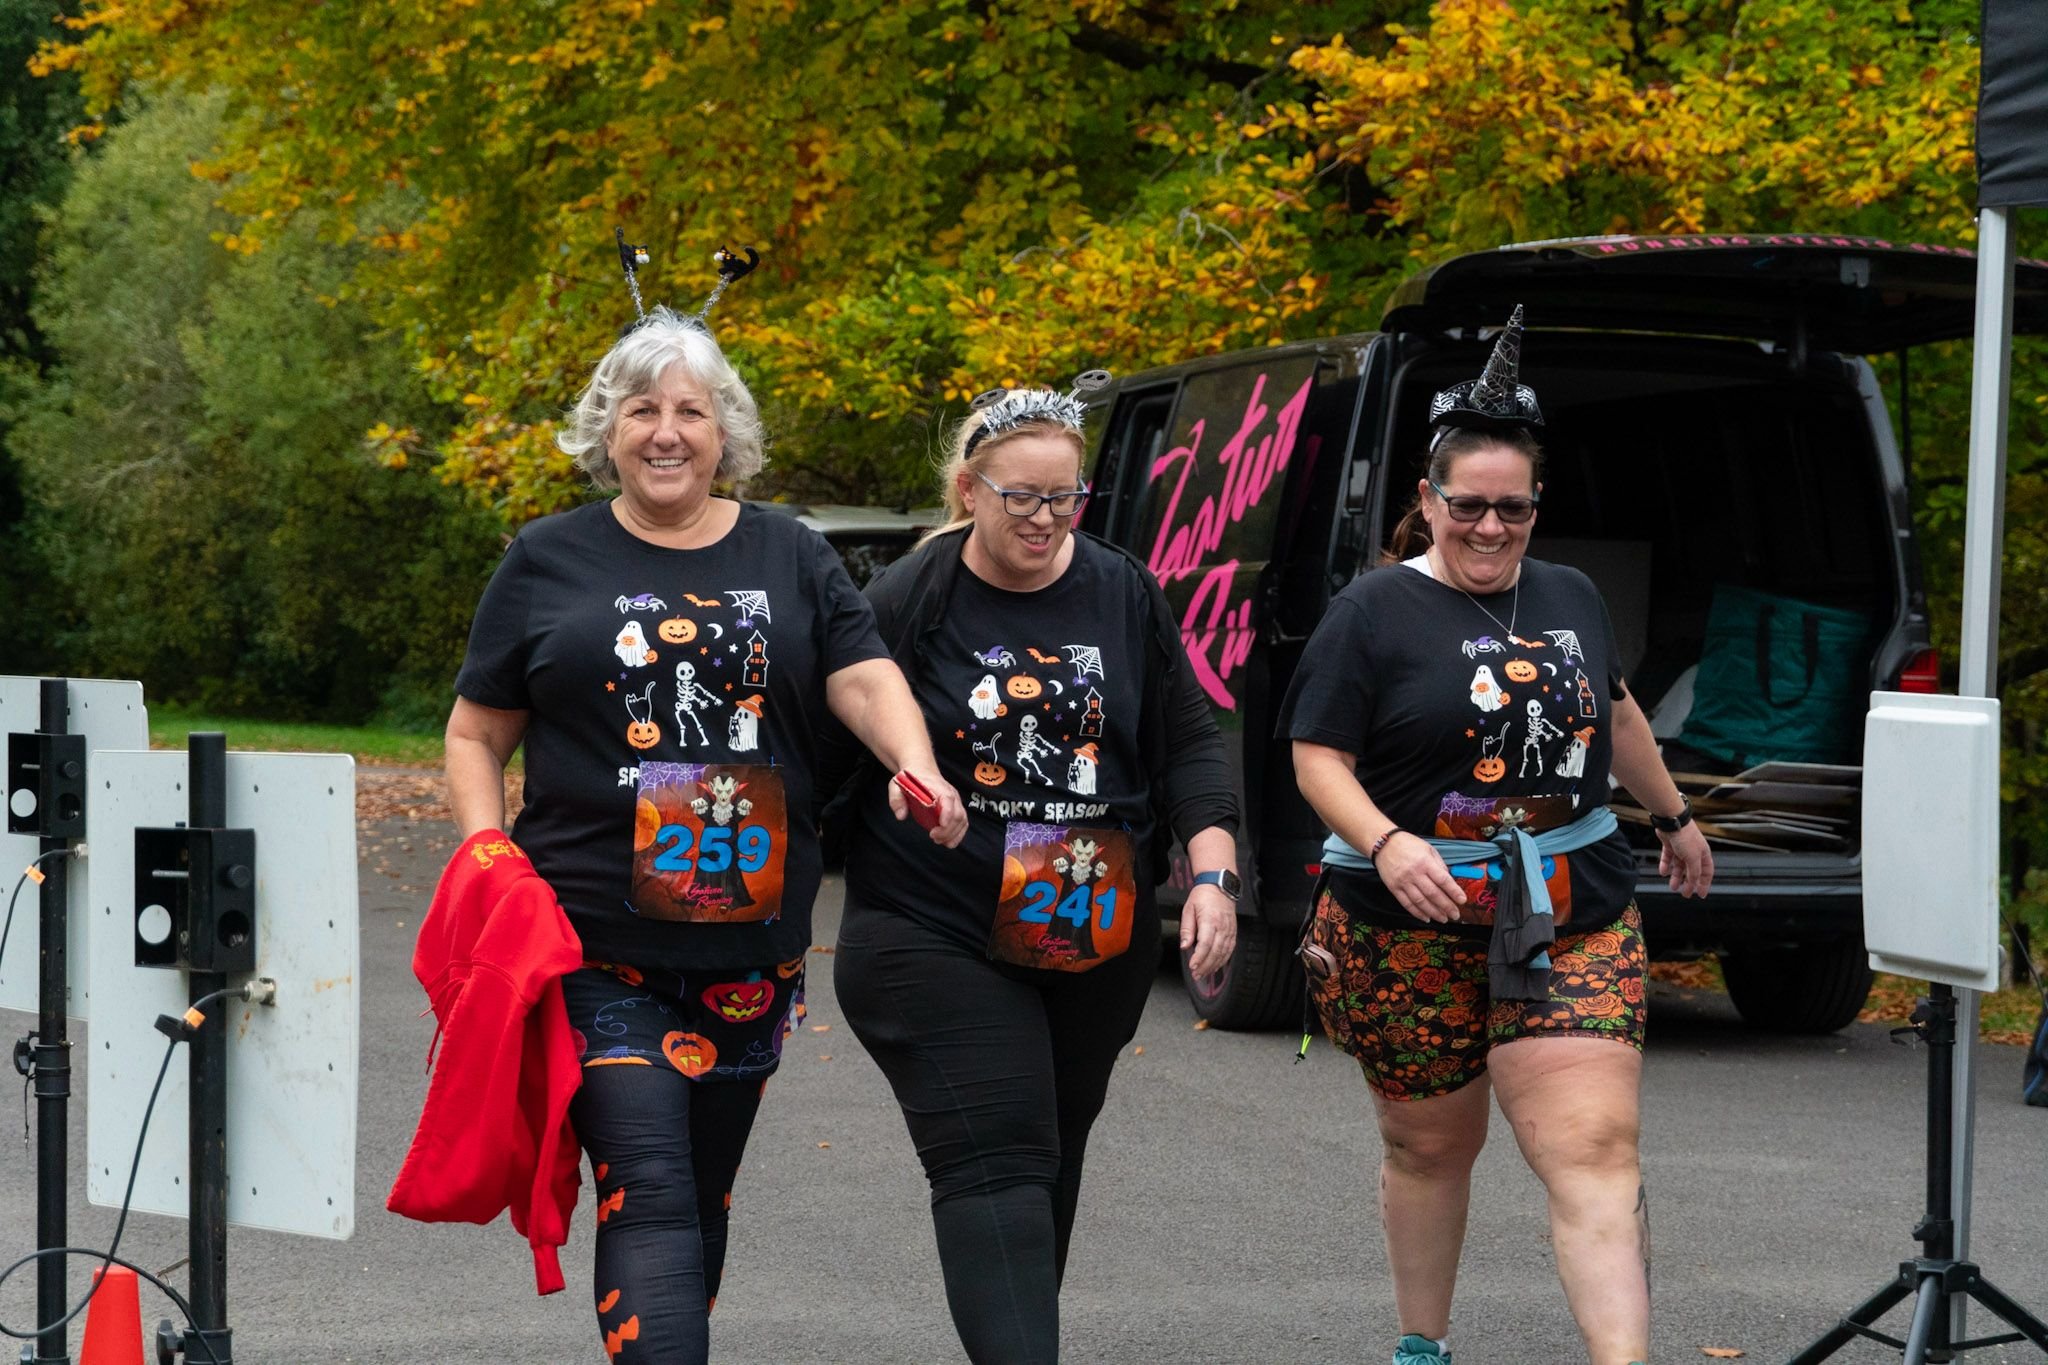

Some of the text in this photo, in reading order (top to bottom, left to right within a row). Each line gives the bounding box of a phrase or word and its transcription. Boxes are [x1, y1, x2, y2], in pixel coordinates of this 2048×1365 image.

[1044, 802, 1110, 823] SEASON
[653, 823, 771, 873] 259
[1018, 881, 1118, 929] 241
